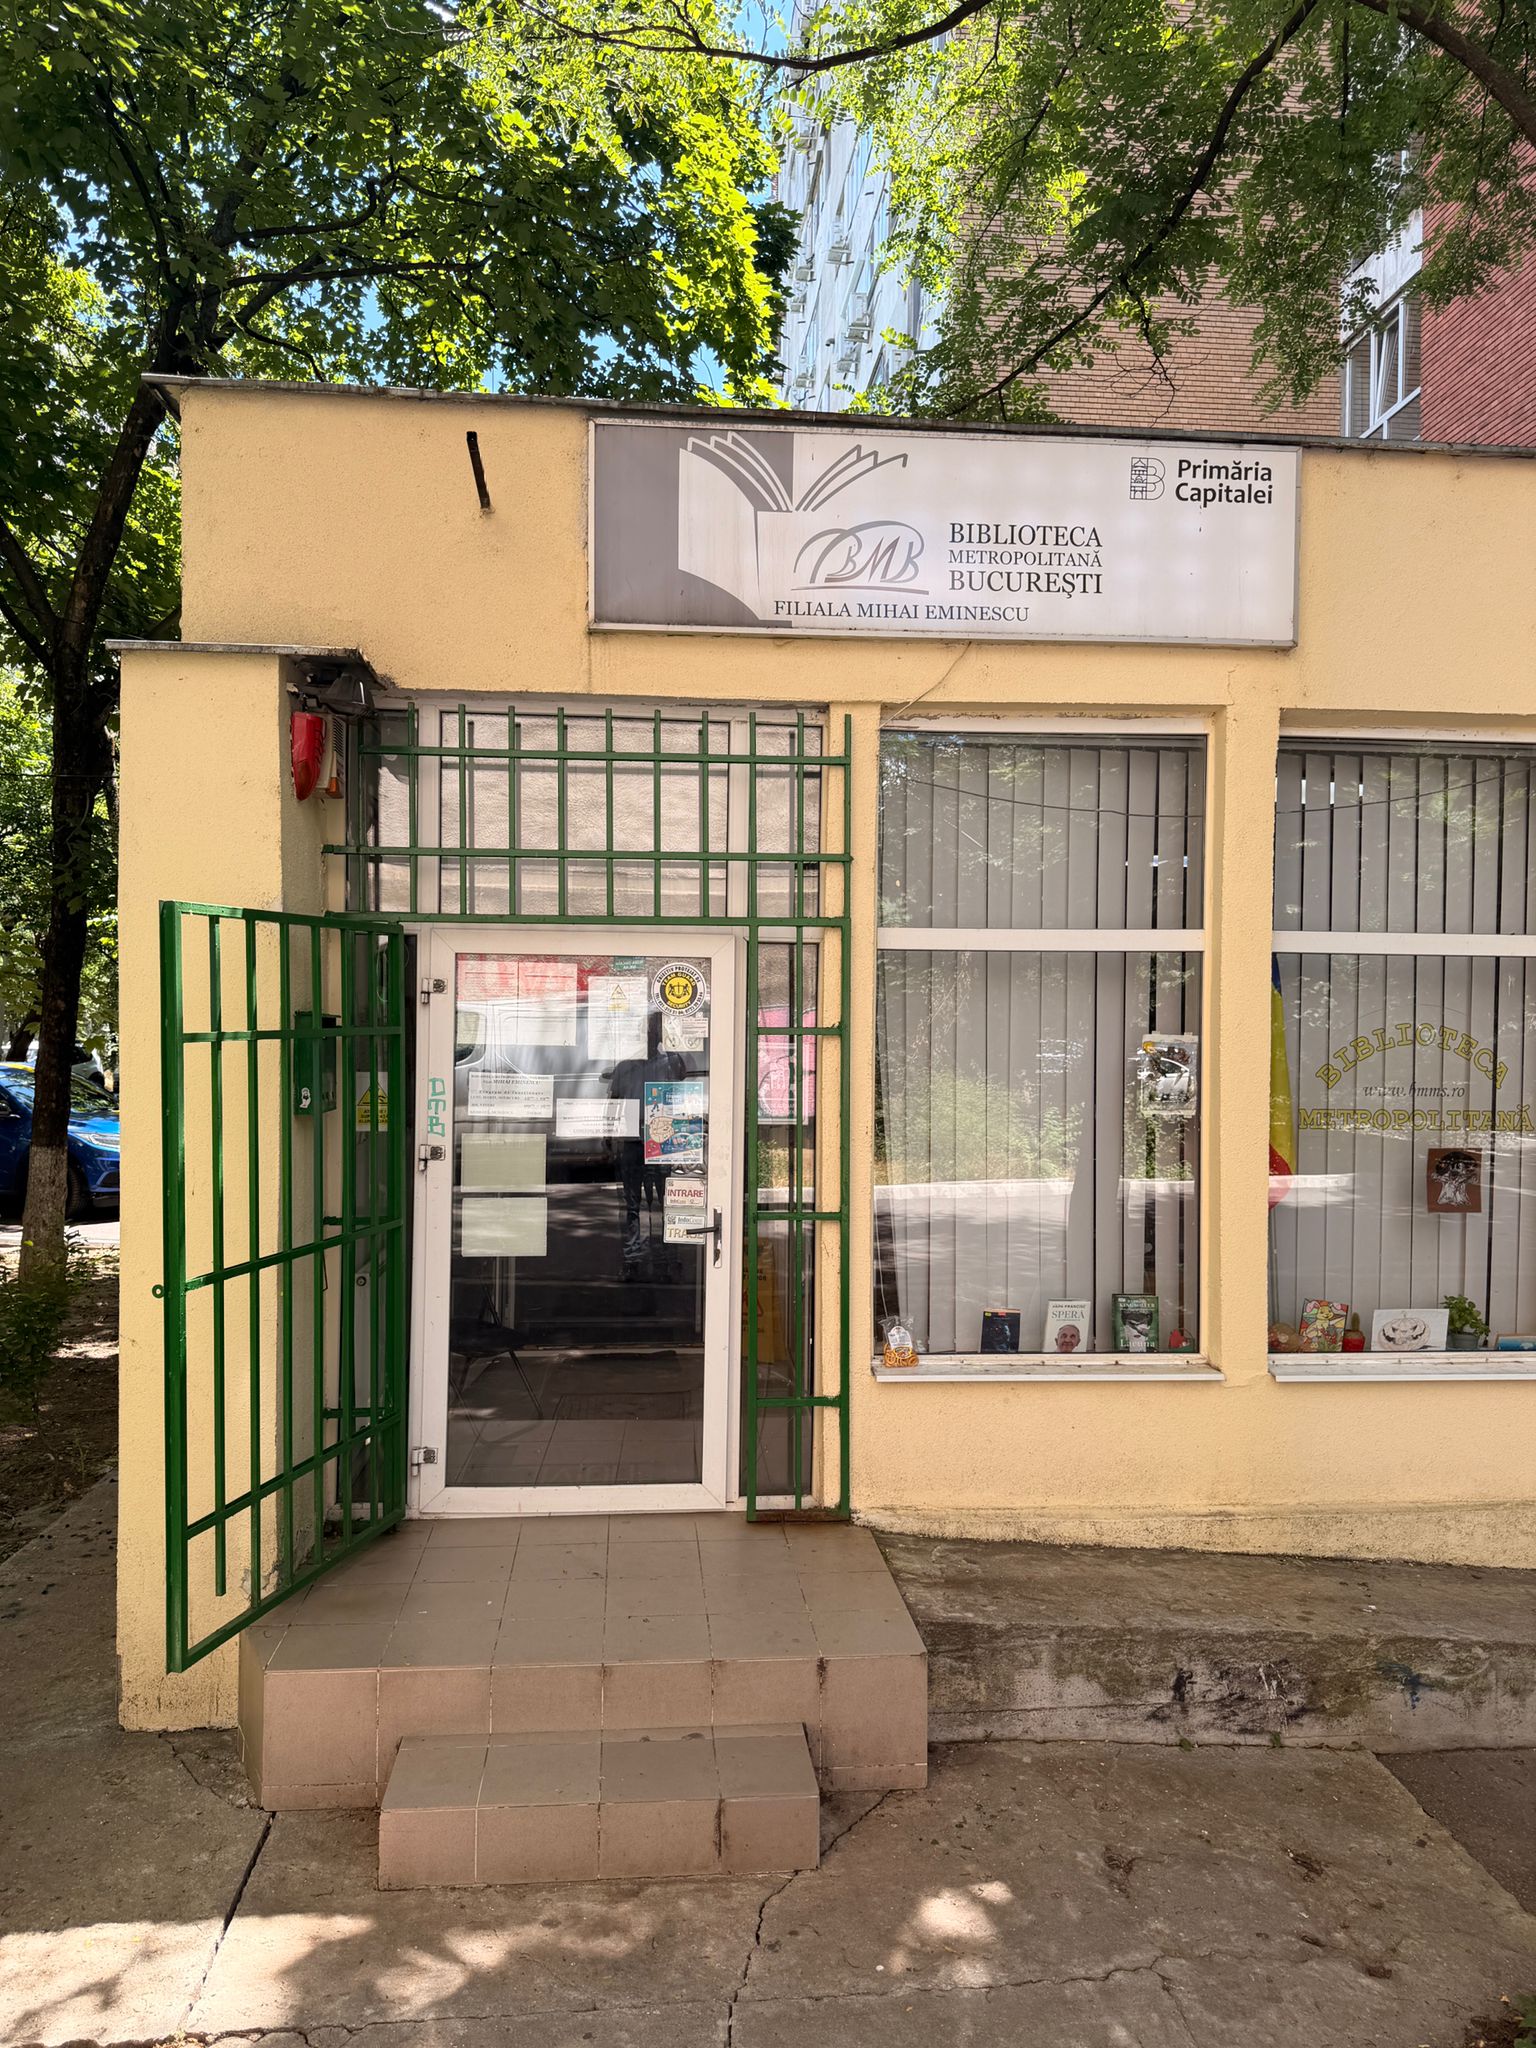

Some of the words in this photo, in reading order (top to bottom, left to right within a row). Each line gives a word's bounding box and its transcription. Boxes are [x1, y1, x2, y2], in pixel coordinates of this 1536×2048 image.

[1178, 459, 1272, 481] Primăria
[1175, 482, 1273, 508] Capitalei
[949, 522, 1103, 547] BIBLIOTECA
[948, 549, 1103, 567] METROPOLITANĂ
[774, 600, 851, 618] FILIALA
[857, 603, 919, 619] MIHAI
[925, 604, 1030, 622] EMINESCU
[1315, 1022, 1509, 1089] BIBLIOTECA
[1299, 1104, 1535, 1132] METROPOLITANĂ
[667, 1189, 704, 1198] INTRARE
